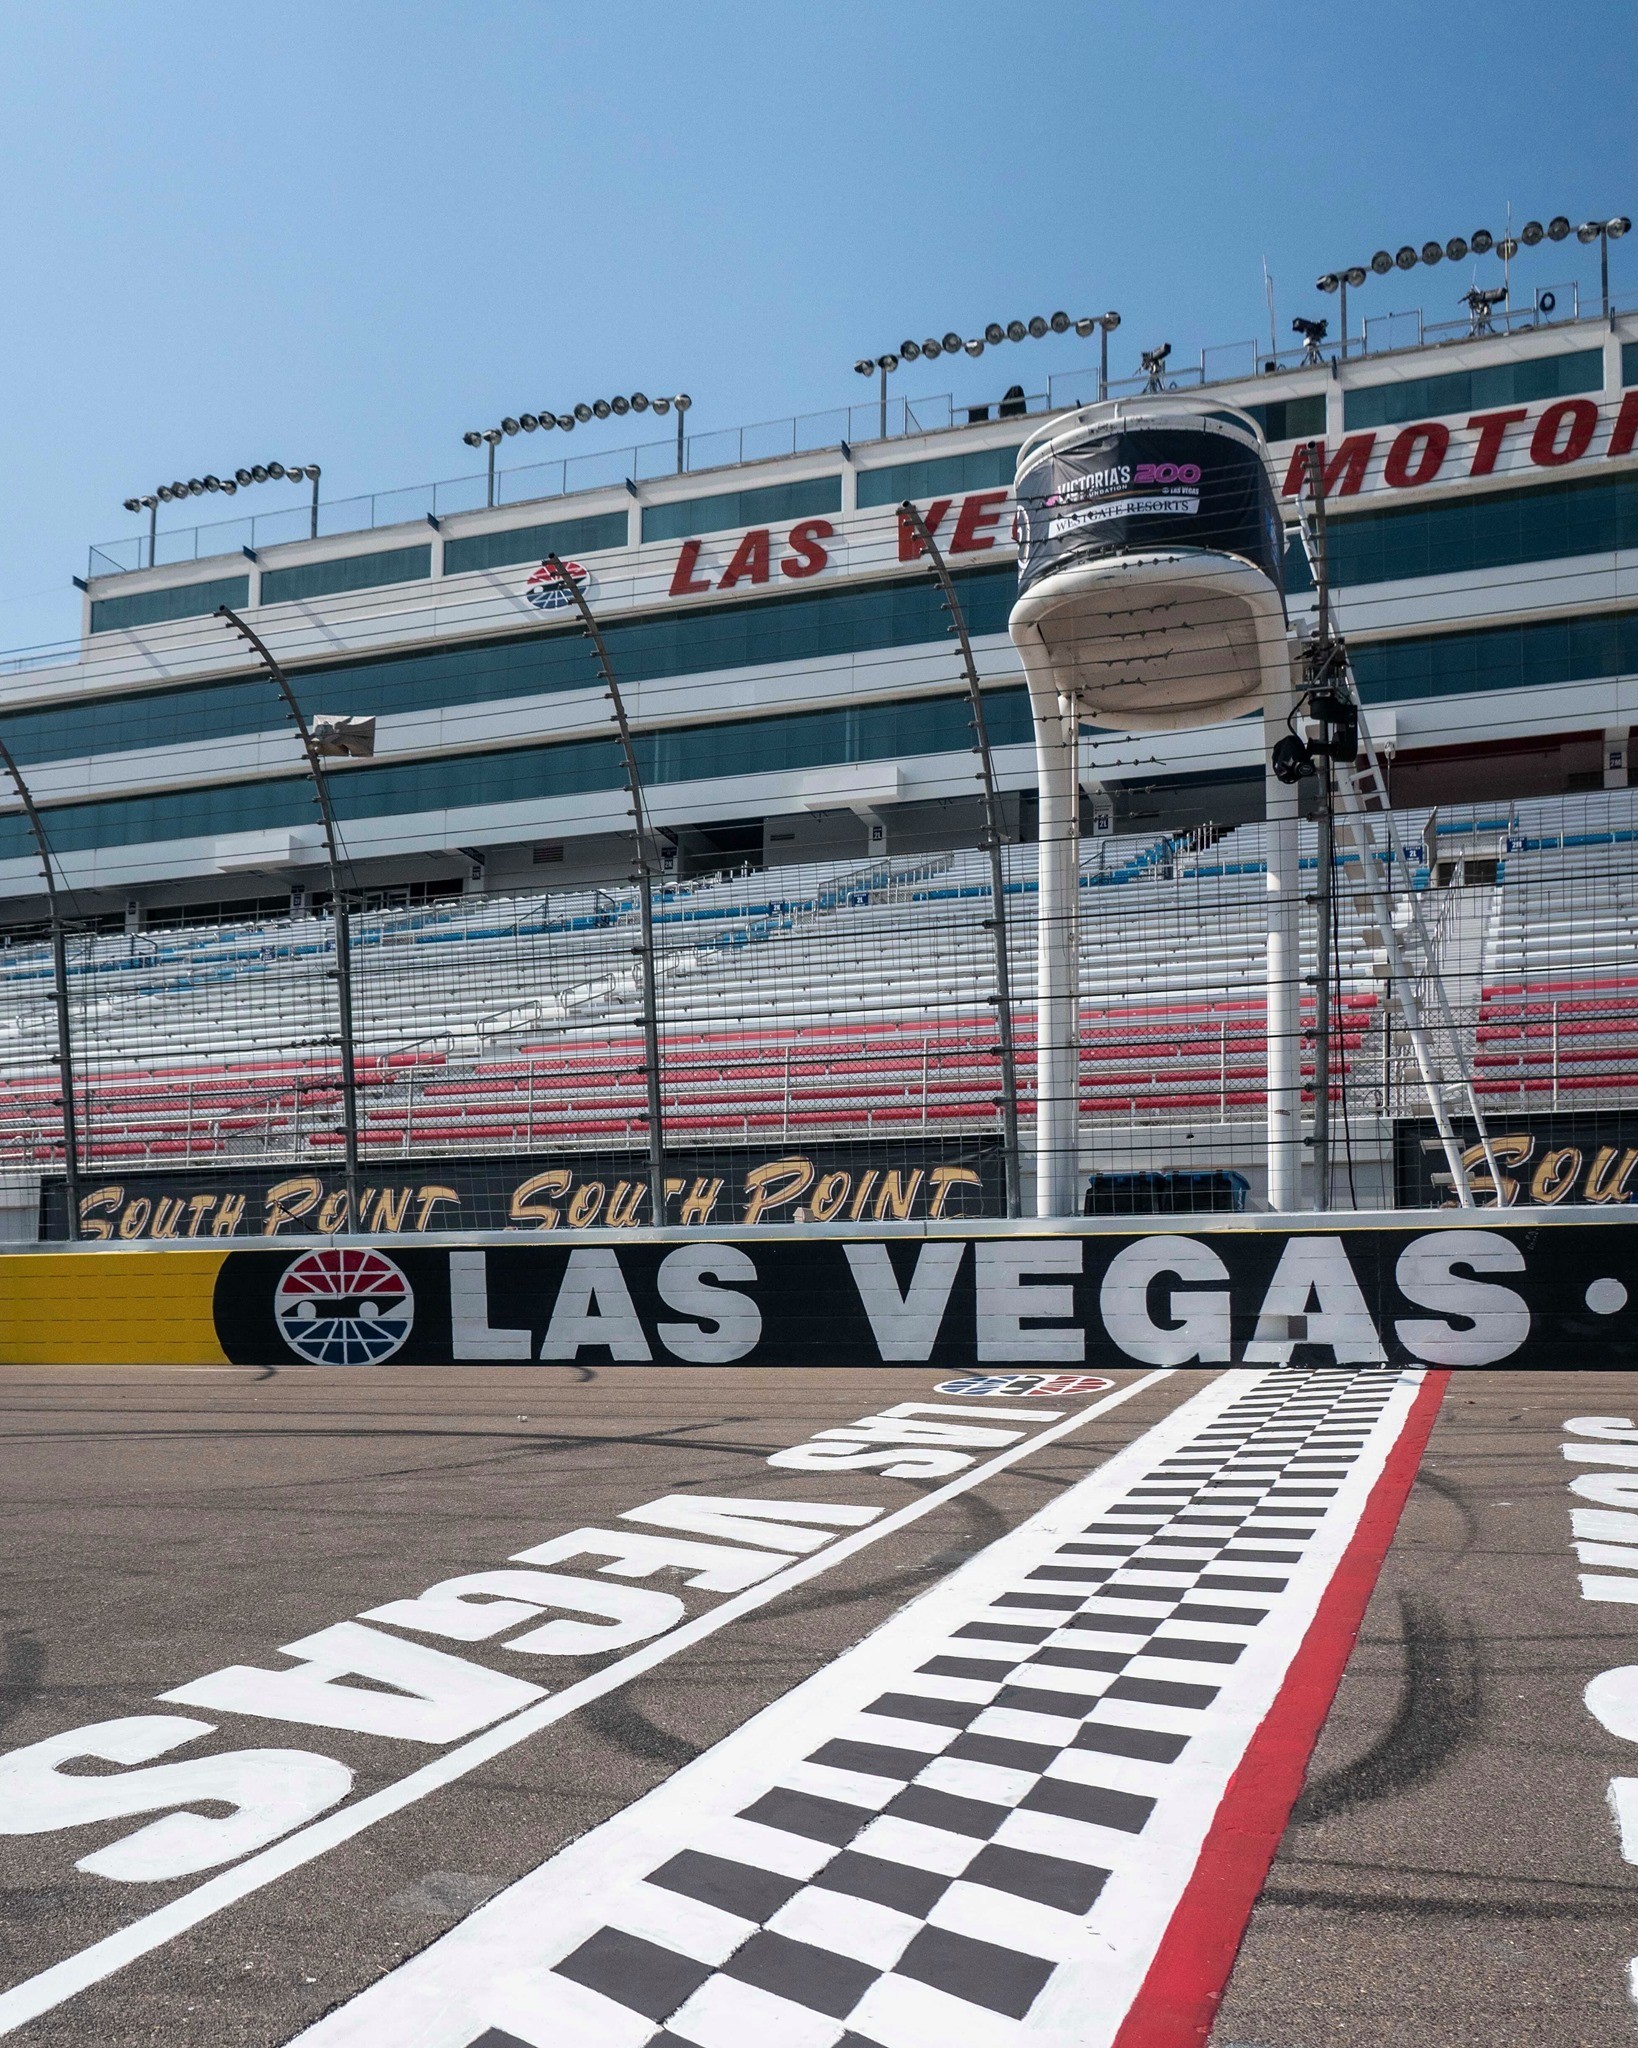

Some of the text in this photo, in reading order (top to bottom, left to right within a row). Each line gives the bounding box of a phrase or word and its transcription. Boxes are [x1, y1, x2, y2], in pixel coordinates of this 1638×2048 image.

[1056, 462, 1201, 496] VICTORIA'S 200
[1170, 486, 1200, 496] LAS VEGAS
[669, 519, 834, 597] LAS
[898, 490, 1018, 562] VE
[1056, 500, 1190, 532] WESTGATE RESORTS
[79, 1175, 462, 1241] SOUTH POINT
[742, 1155, 983, 1223] POINT
[449, 1230, 1532, 1366] LAS VEGAS
[766, 1402, 1066, 1478] LAS
[0, 1493, 885, 1883] VEGAS
